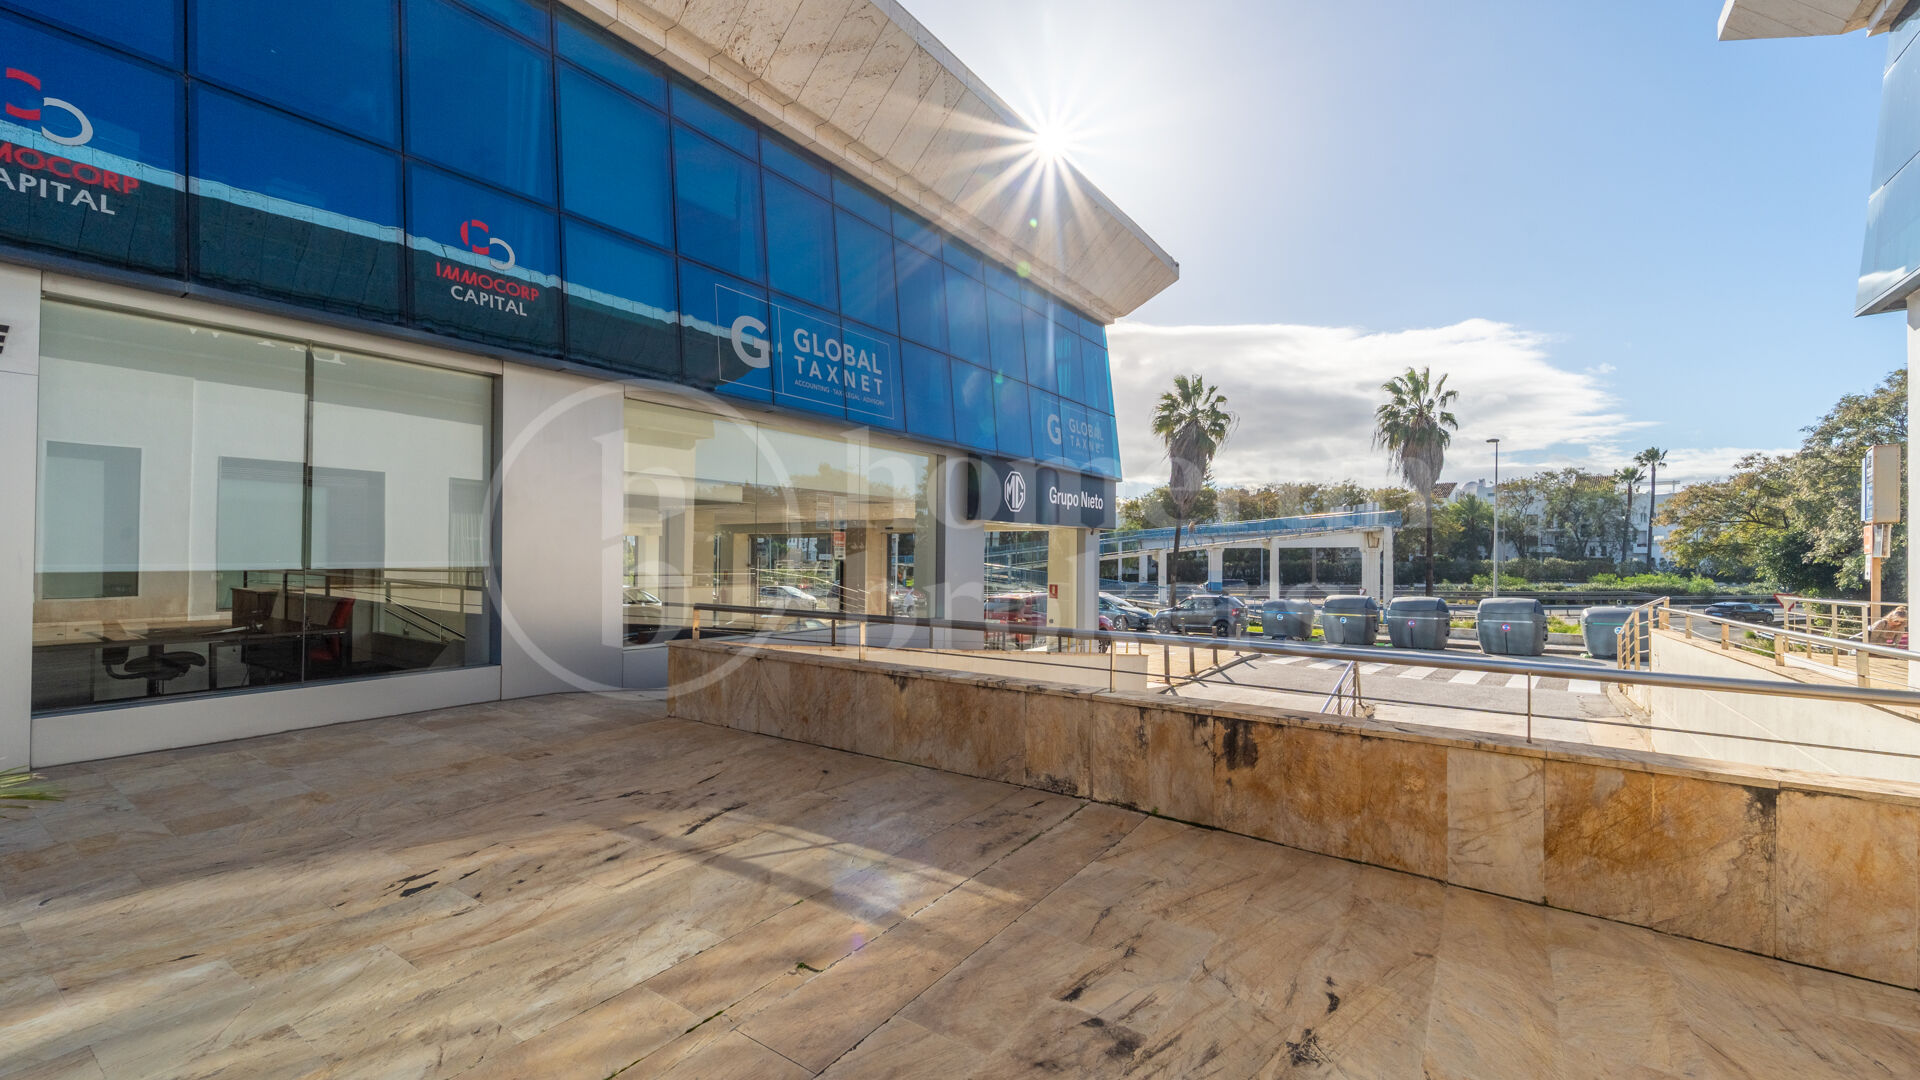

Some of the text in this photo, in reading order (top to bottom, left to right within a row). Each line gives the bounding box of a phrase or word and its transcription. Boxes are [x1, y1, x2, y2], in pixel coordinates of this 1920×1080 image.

[436, 261, 539, 301] IMMOCORP
[451, 285, 527, 317] CAPITAL
[731, 315, 773, 369] G
[793, 328, 882, 375] GLOBAL
[793, 355, 883, 395] TAXNET
[794, 379, 830, 393] ACCOUNTING
[1047, 413, 1062, 445] G
[1069, 418, 1104, 441] GLOBAL
[1006, 474, 1025, 509] MG
[1049, 486, 1104, 510] Grupo Nieto
